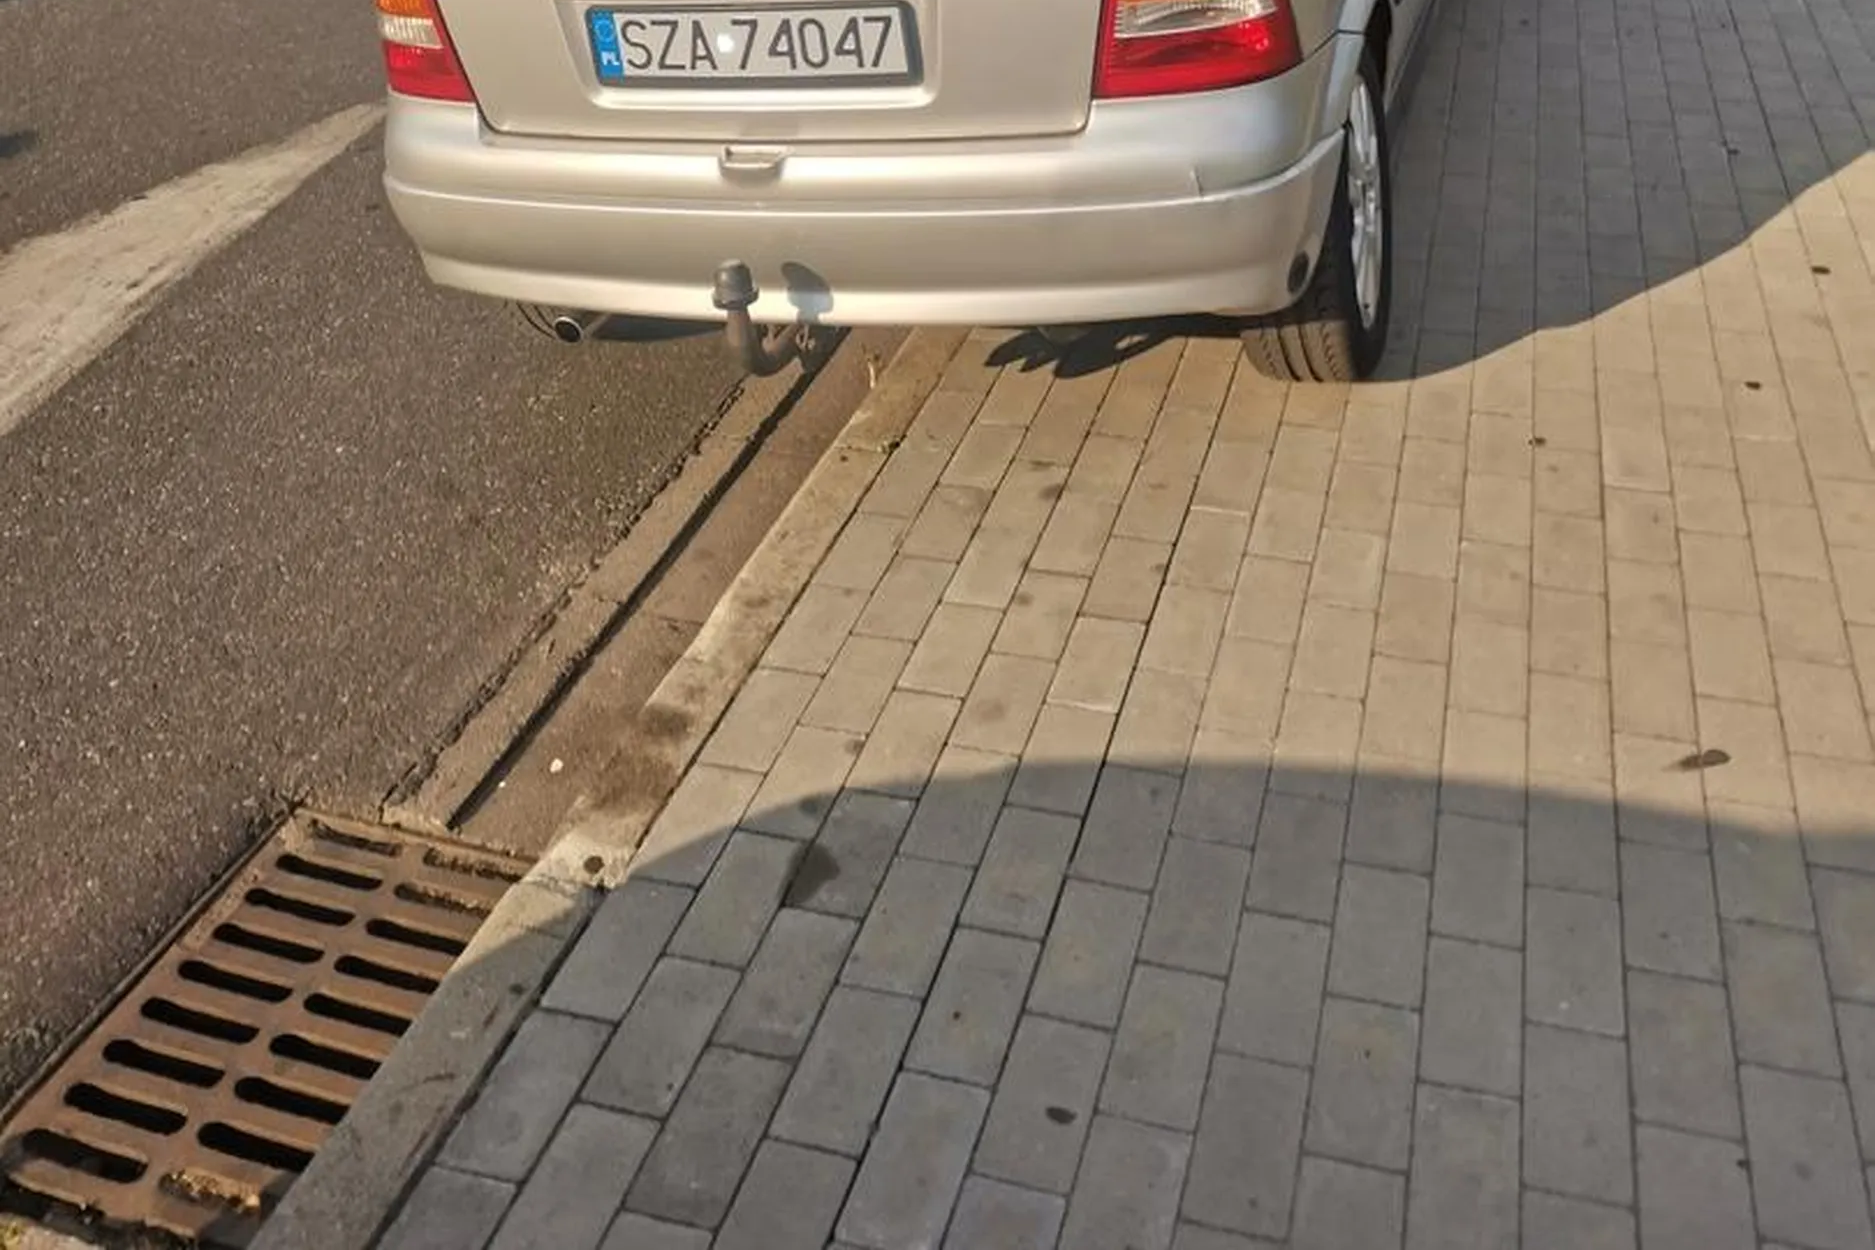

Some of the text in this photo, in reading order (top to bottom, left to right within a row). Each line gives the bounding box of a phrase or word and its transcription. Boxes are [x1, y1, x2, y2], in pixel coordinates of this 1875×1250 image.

[601, 51, 620, 65] PL
[620, 15, 893, 71] SZA 74047
